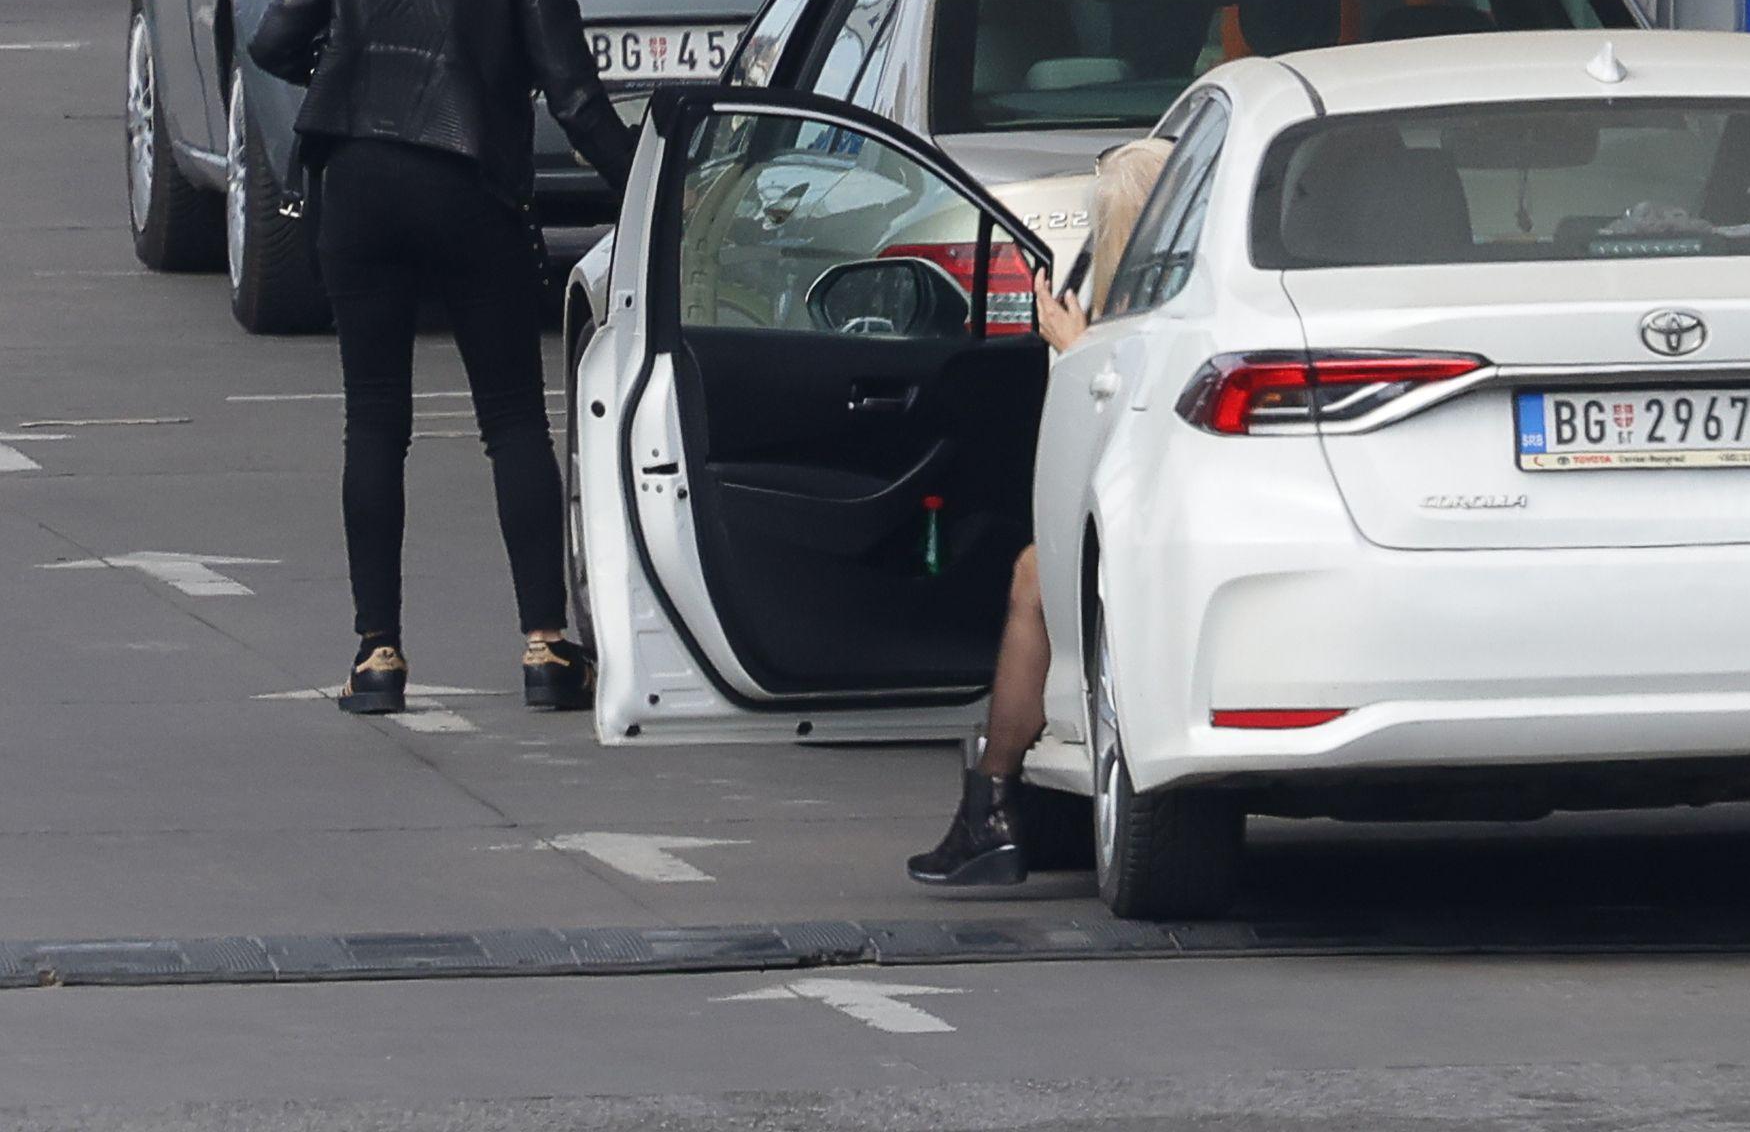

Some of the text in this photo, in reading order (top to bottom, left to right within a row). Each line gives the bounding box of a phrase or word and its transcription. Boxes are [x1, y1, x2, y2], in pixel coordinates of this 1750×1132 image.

[592, 31, 743, 71] BG 45
[1049, 211, 1089, 229] 22
[1554, 399, 1607, 445] BG
[1521, 433, 1544, 447] SRB
